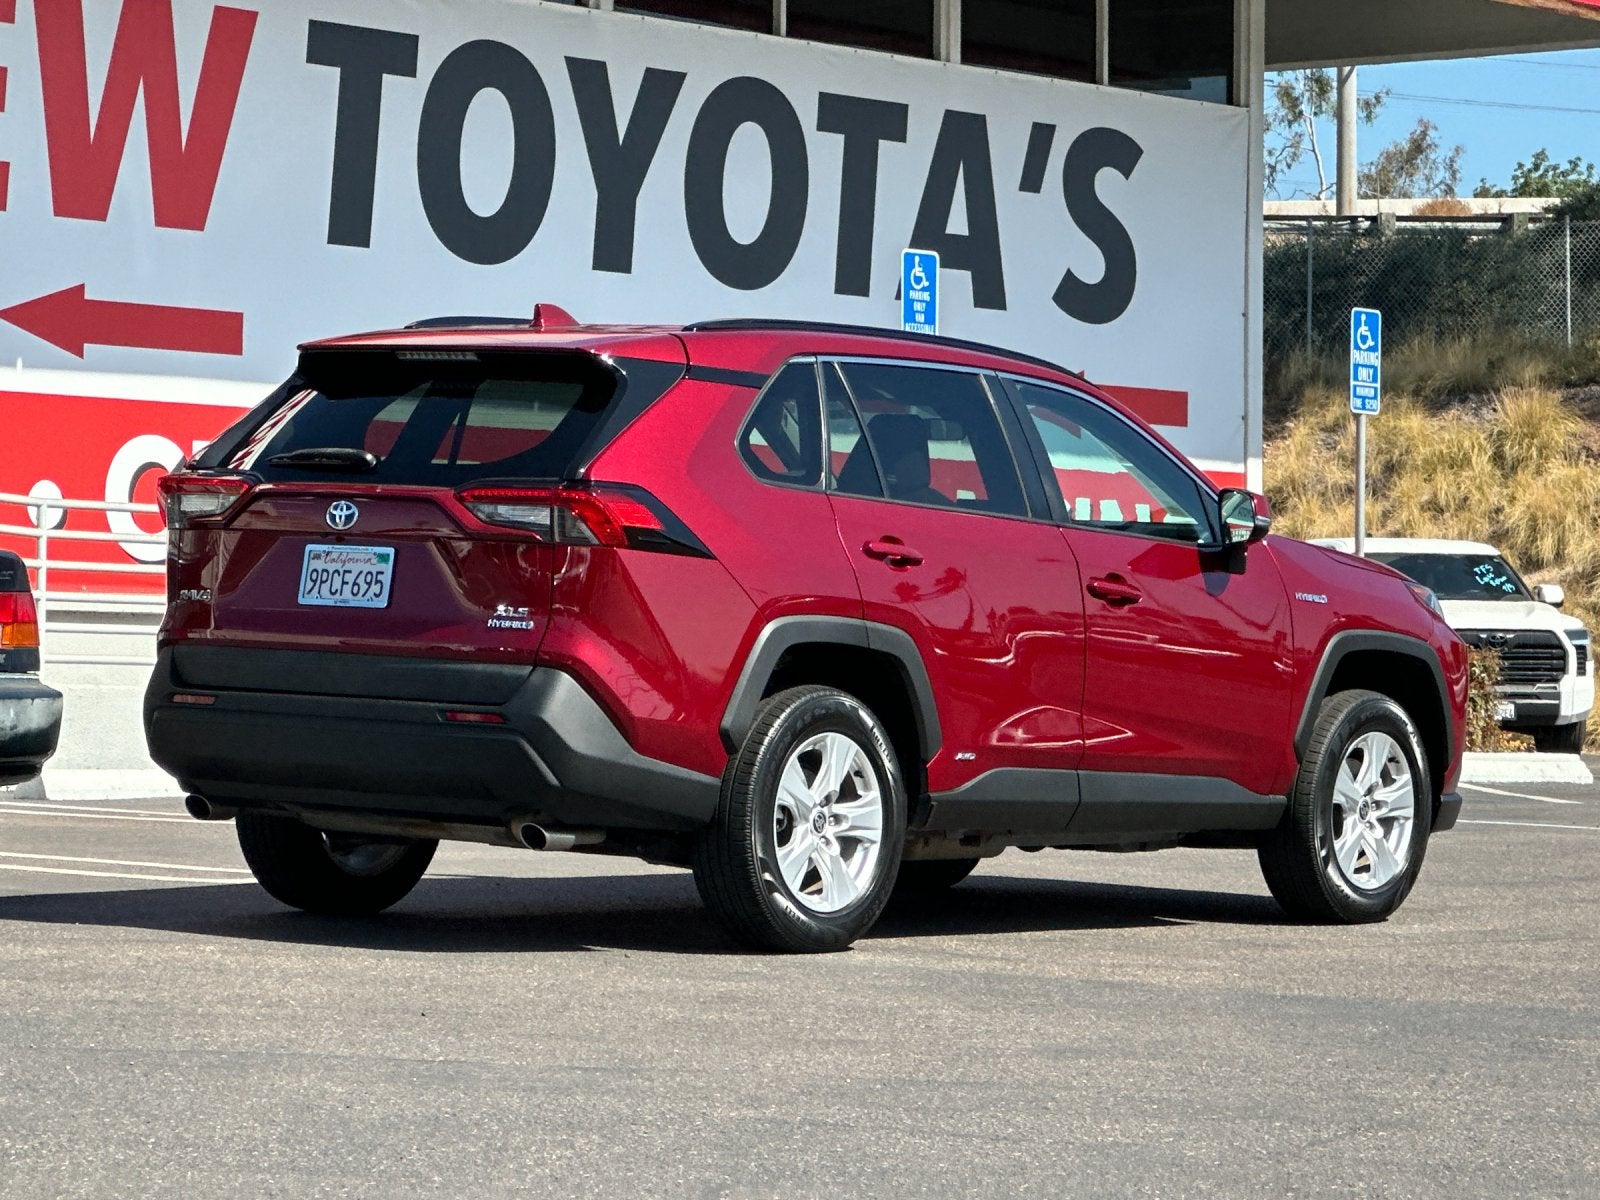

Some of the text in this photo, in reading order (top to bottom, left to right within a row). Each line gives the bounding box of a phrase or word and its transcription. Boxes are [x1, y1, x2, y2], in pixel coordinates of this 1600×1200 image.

[307, 19, 1143, 324] TOYOTA'S
[1353, 350, 1379, 366] PARKING
[1358, 367, 1374, 382] ONLY
[322, 550, 377, 568] California
[306, 568, 385, 599] 9PCF695
[487, 618, 535, 630] HYBRID
